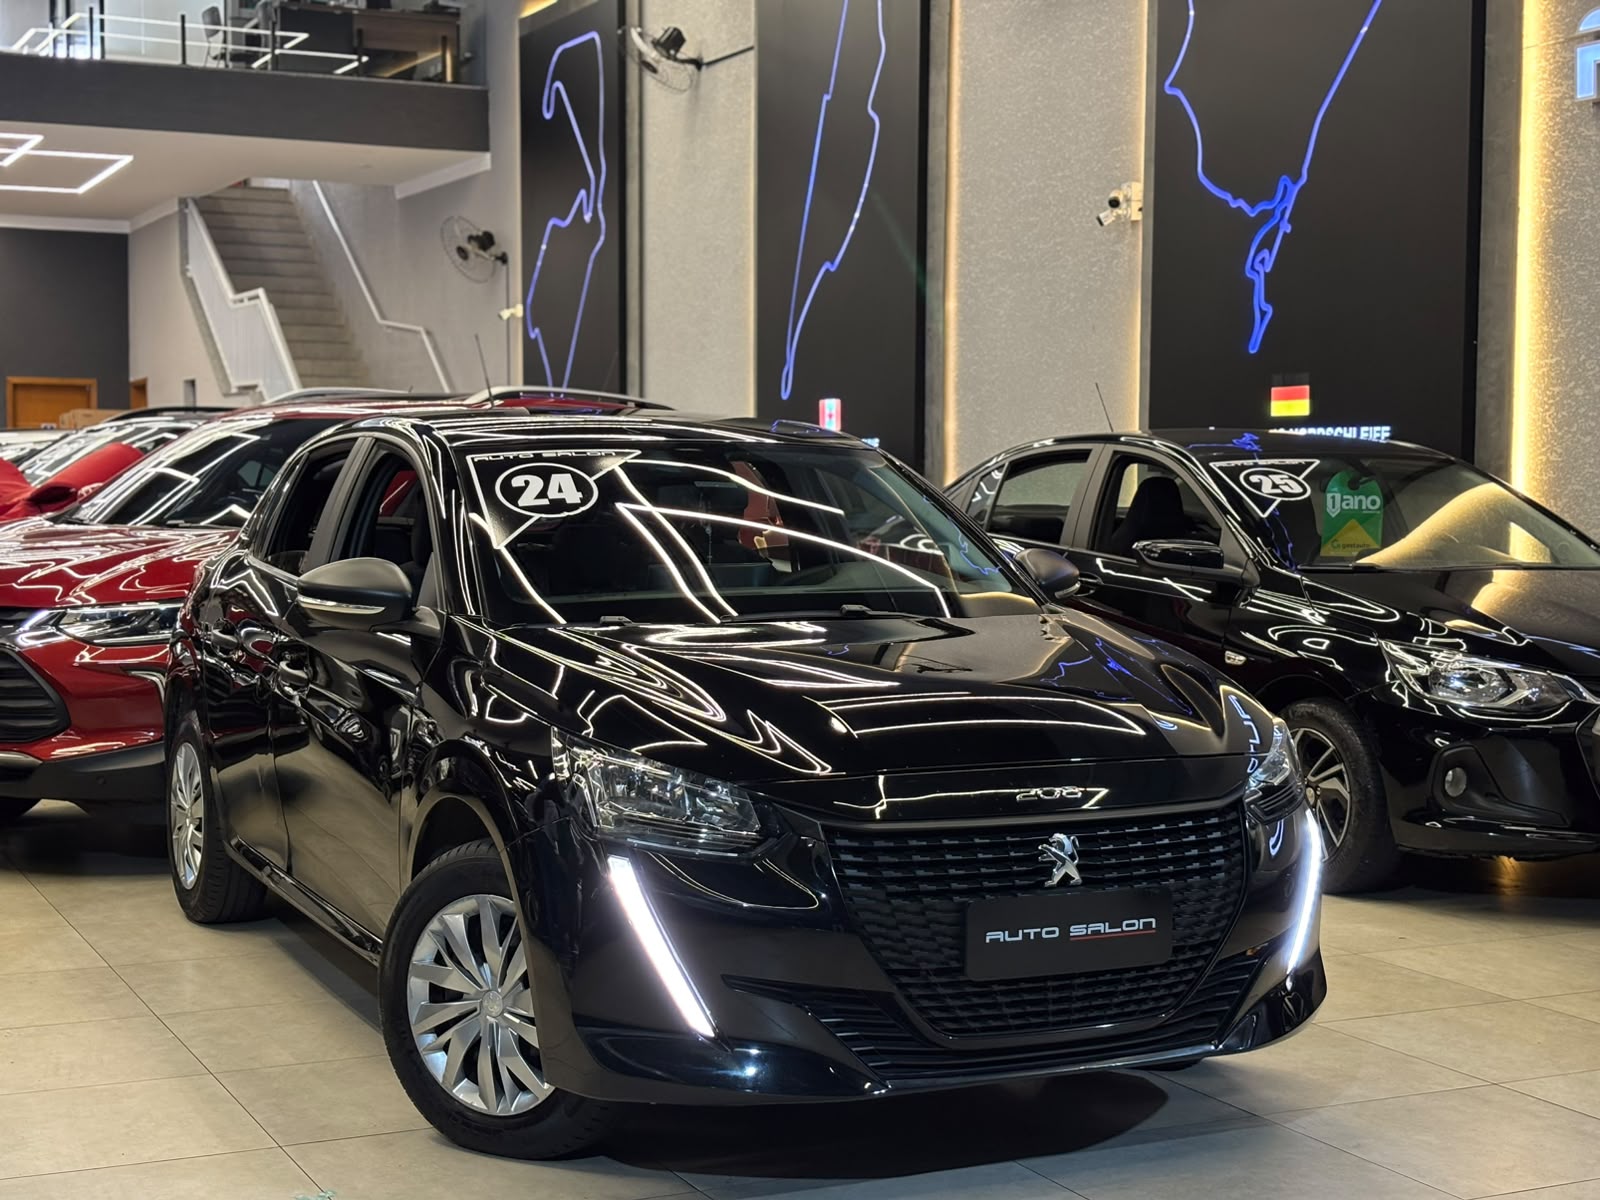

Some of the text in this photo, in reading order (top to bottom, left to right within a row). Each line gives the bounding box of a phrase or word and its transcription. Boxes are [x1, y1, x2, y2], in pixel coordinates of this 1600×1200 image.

[510, 473, 583, 507] 24
[1248, 474, 1303, 494] 25
[985, 918, 1156, 943] AUTO SALON
